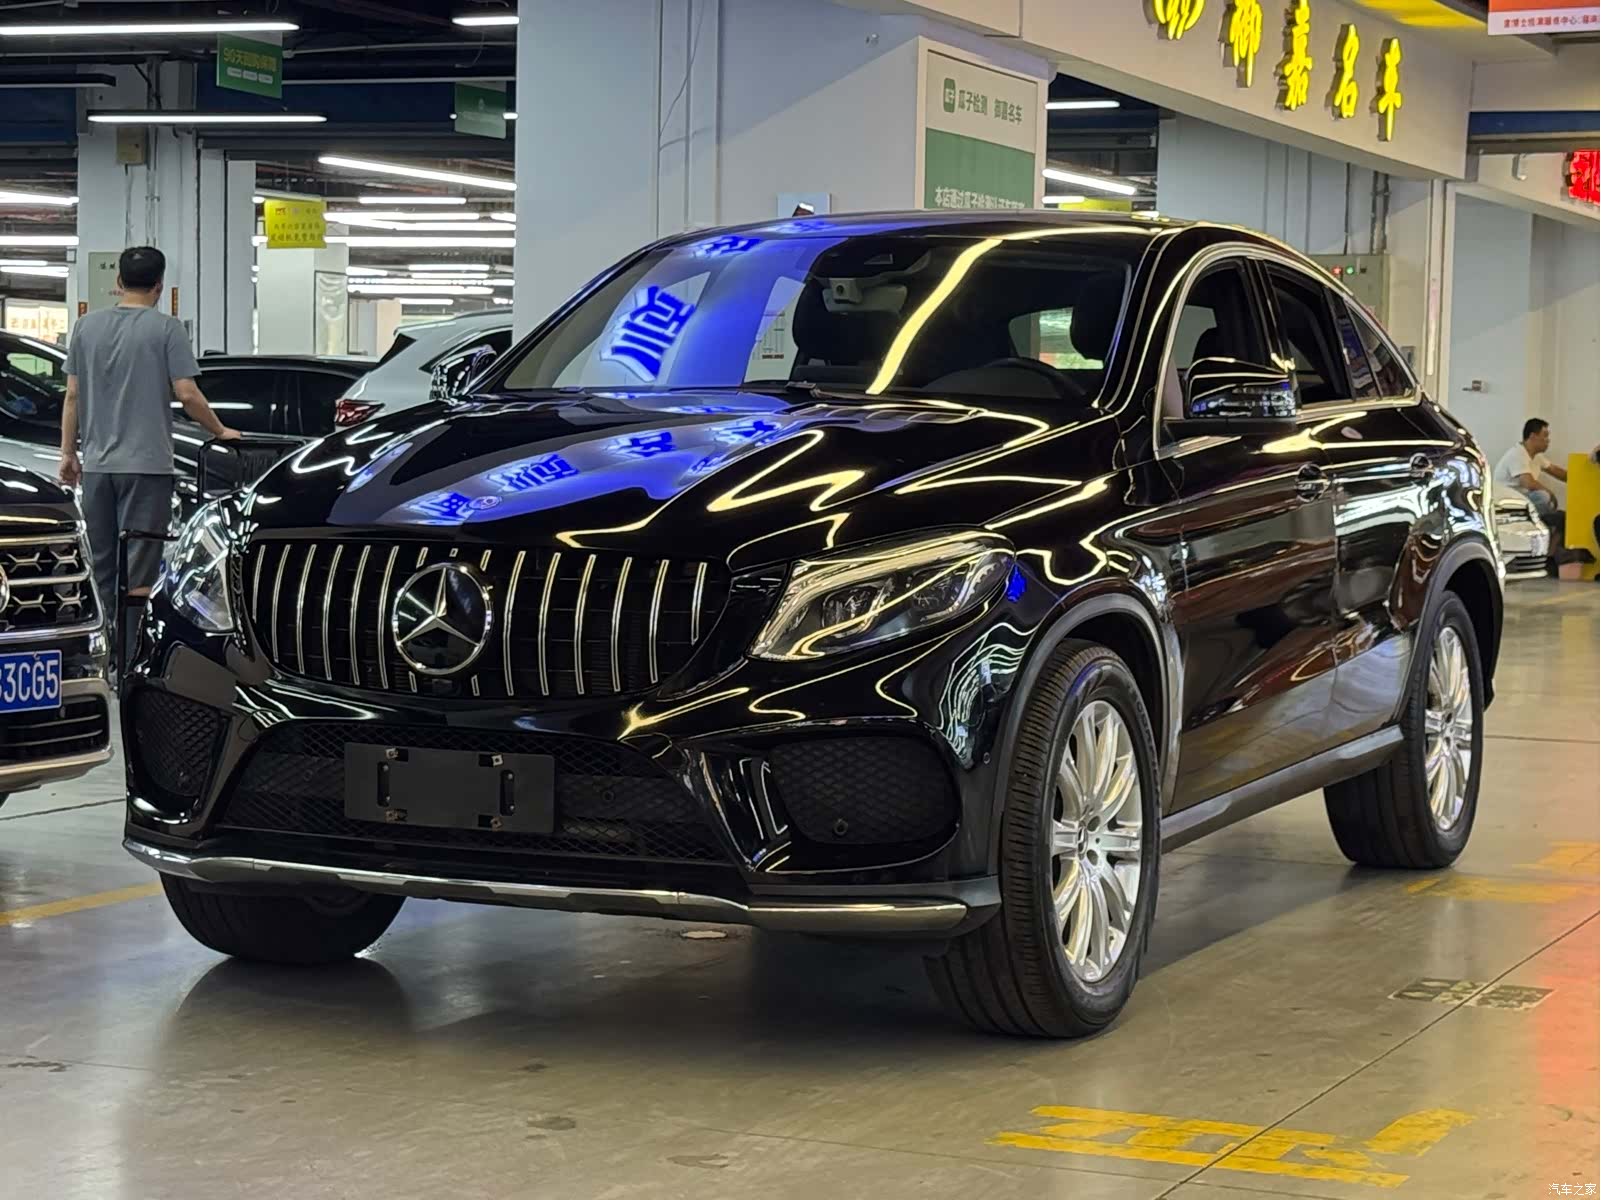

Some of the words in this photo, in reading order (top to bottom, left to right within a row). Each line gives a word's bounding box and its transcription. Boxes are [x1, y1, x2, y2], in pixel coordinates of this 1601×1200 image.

[958, 89, 988, 115] 瓜子检测
[0, 659, 59, 703] 3CG5
